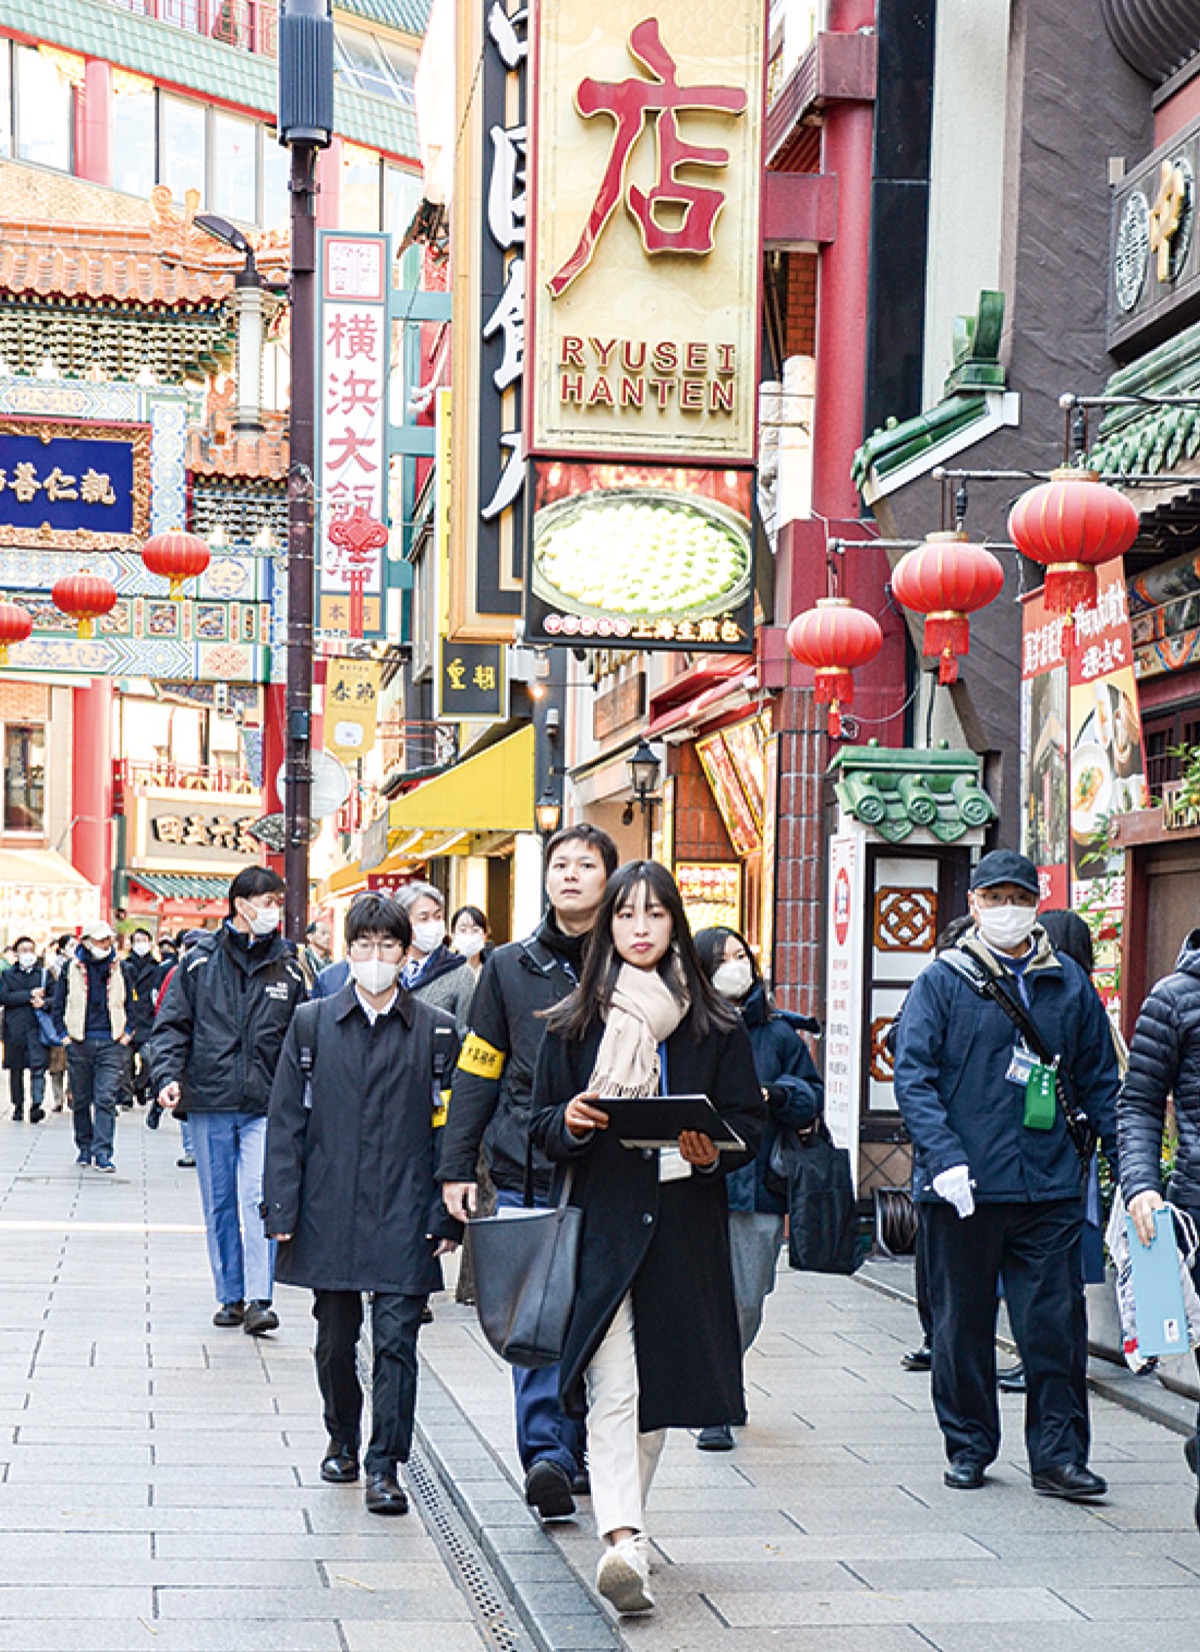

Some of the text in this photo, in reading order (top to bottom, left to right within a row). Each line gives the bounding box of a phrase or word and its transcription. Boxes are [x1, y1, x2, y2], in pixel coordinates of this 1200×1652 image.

[546, 16, 748, 299] 店
[561, 336, 736, 373] RYUSEI
[561, 376, 735, 412] HANTEN
